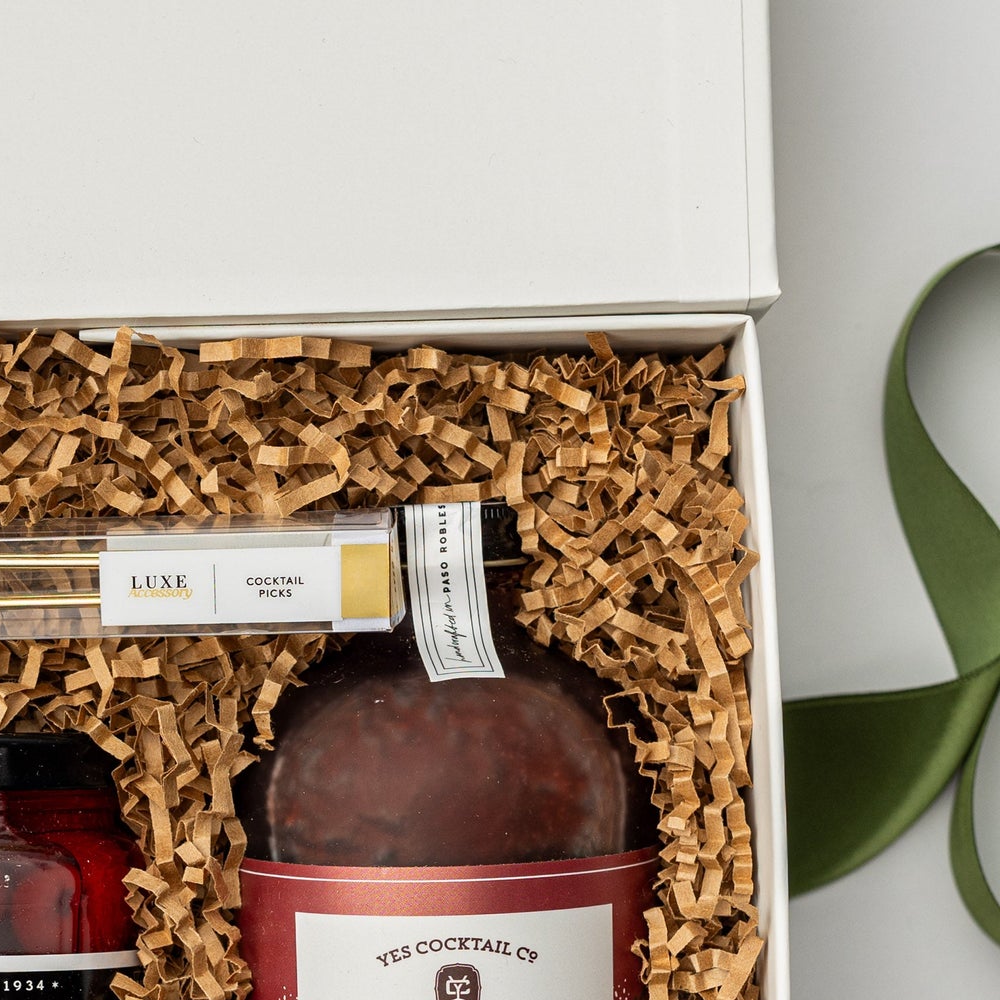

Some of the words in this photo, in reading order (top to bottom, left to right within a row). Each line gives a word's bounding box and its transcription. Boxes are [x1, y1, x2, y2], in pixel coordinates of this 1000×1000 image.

[437, 504, 449, 553] ROBLES
[131, 574, 187, 590] LUXE
[246, 576, 305, 586] COCKTAIL
[440, 561, 452, 594] PASO
[128, 587, 193, 601] Accessory
[258, 588, 293, 598] PICKS
[375, 945, 412, 967] YES
[415, 937, 511, 956] COCKTAIL
[3, 979, 45, 991] 1934
